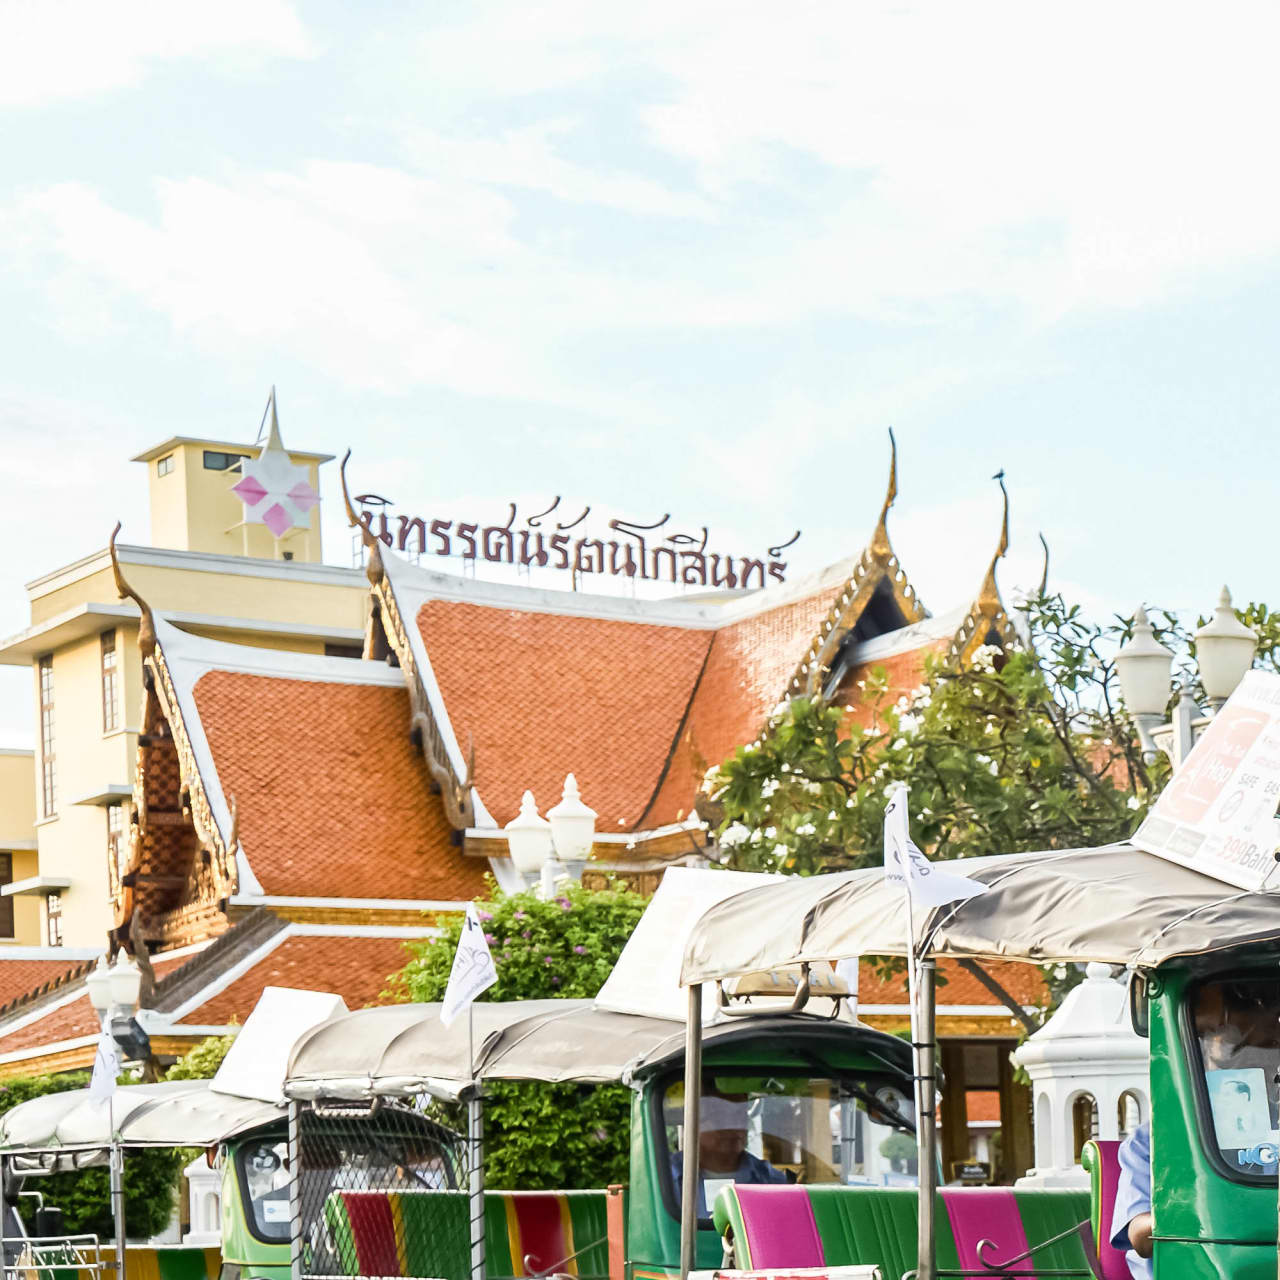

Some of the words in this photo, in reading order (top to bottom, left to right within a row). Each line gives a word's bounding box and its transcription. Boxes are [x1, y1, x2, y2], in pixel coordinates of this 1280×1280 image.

[354, 495, 801, 590] นิทรรศน์รัตนโกสินทร์
